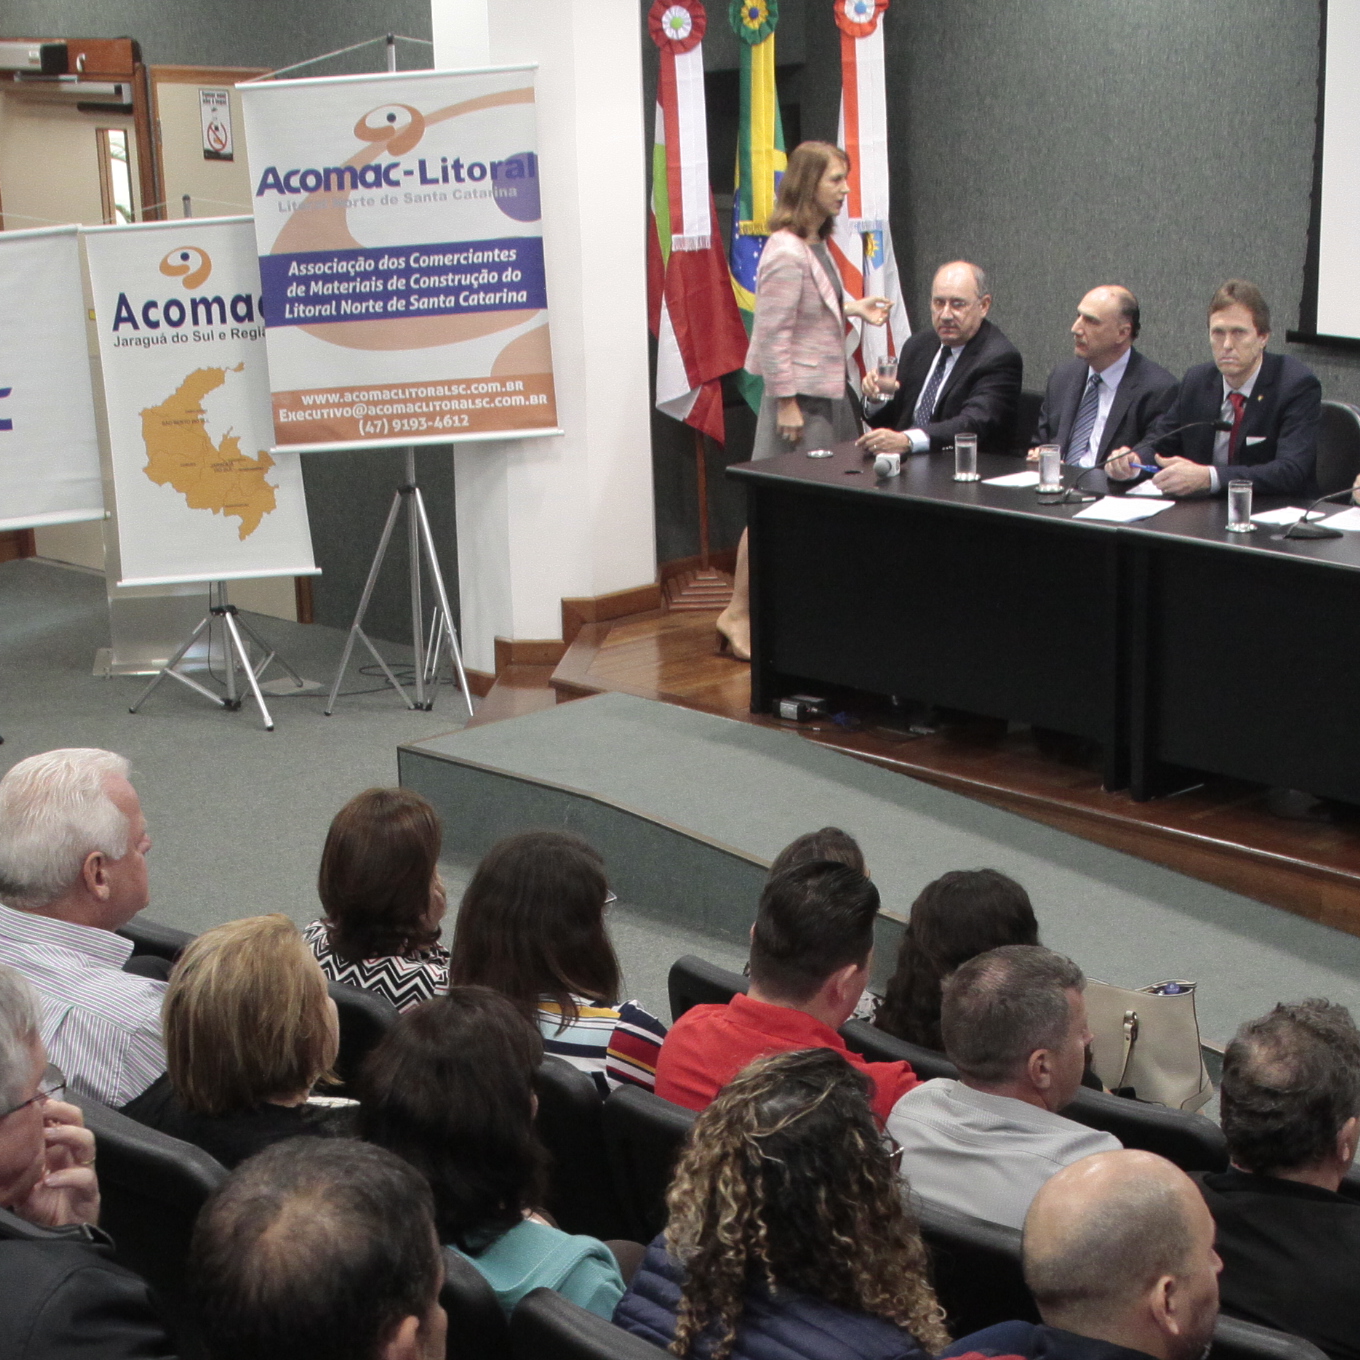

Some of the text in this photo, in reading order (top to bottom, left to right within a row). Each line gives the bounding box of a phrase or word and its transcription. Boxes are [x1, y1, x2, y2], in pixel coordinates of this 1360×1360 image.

[256, 151, 536, 197] Acomac-Litoral
[380, 193, 398, 206] de
[404, 191, 447, 205] Santa
[453, 186, 518, 201] Catarina
[288, 248, 517, 277] Associação dos Comerciantes
[287, 266, 522, 297] de Materiais de Construção do
[285, 289, 527, 319] Litoral Norte de Santa Catarina
[113, 332, 167, 349] Jaraguá
[171, 331, 188, 344] do
[192, 329, 214, 342] Sul
[218, 331, 226, 341] e
[358, 414, 470, 436] (47) 9193-4612
